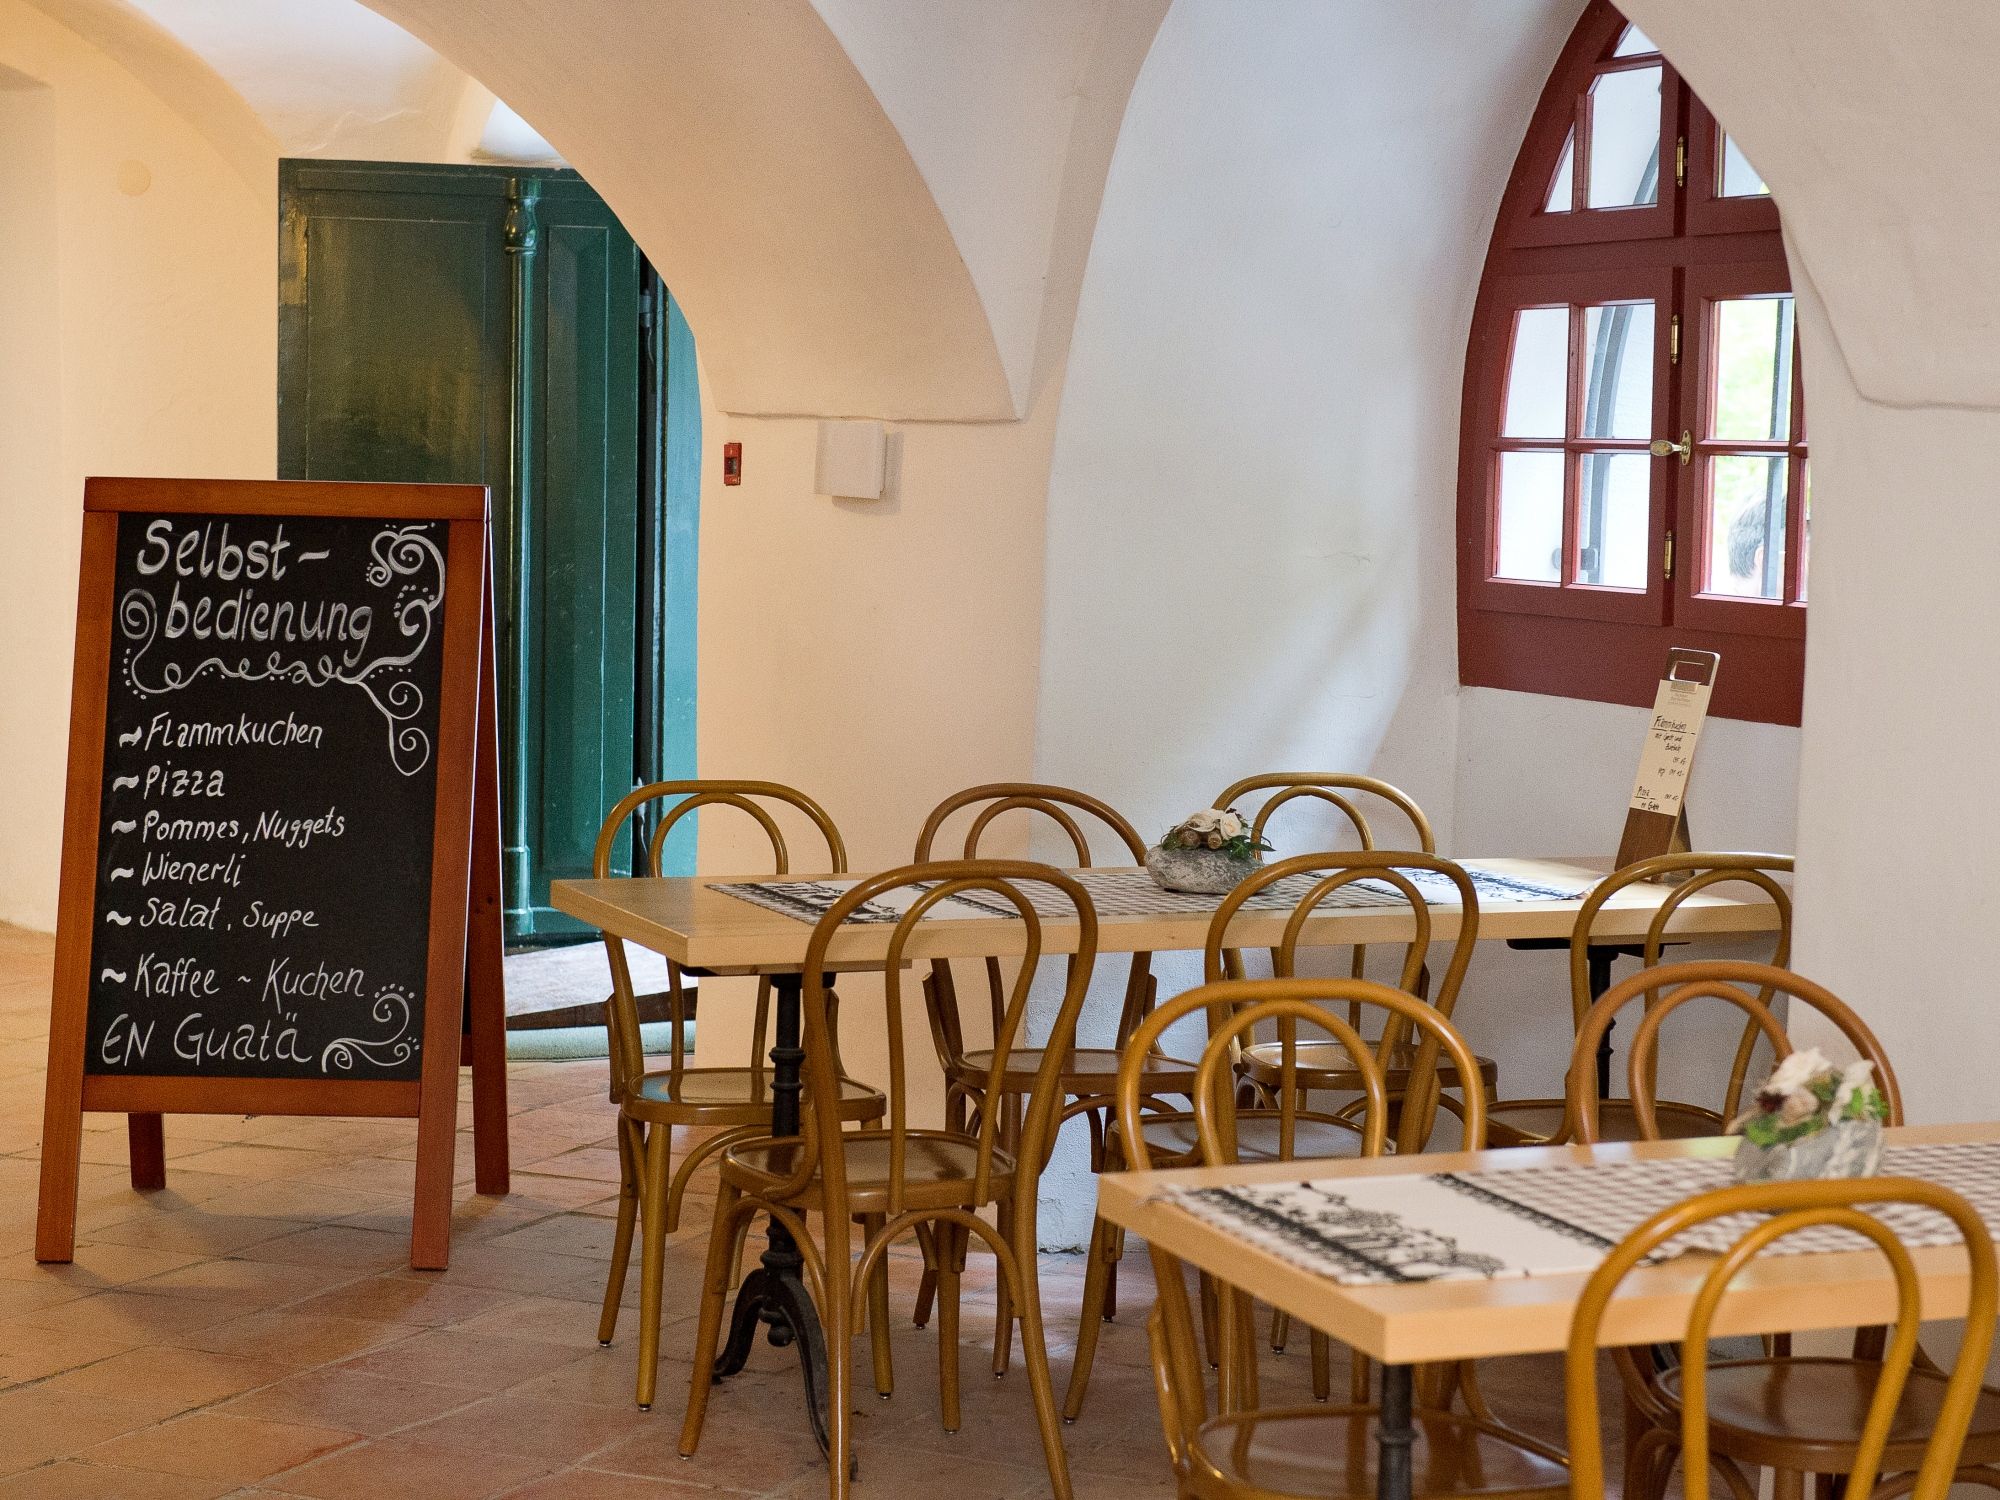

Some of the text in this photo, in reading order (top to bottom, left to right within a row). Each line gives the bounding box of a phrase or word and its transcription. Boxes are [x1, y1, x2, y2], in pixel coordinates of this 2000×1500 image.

[136, 519, 330, 581] Selbst-
[164, 581, 372, 667] bedienung
[144, 711, 323, 752] Flammkuchen
[143, 760, 226, 800] Pizza
[142, 806, 345, 849] Pommes, Nuggets
[141, 851, 246, 888] Wienerli
[242, 900, 320, 939] Suppe
[134, 952, 365, 1014] Kaffee Kuchen
[101, 1012, 313, 1067] EN Guatä
